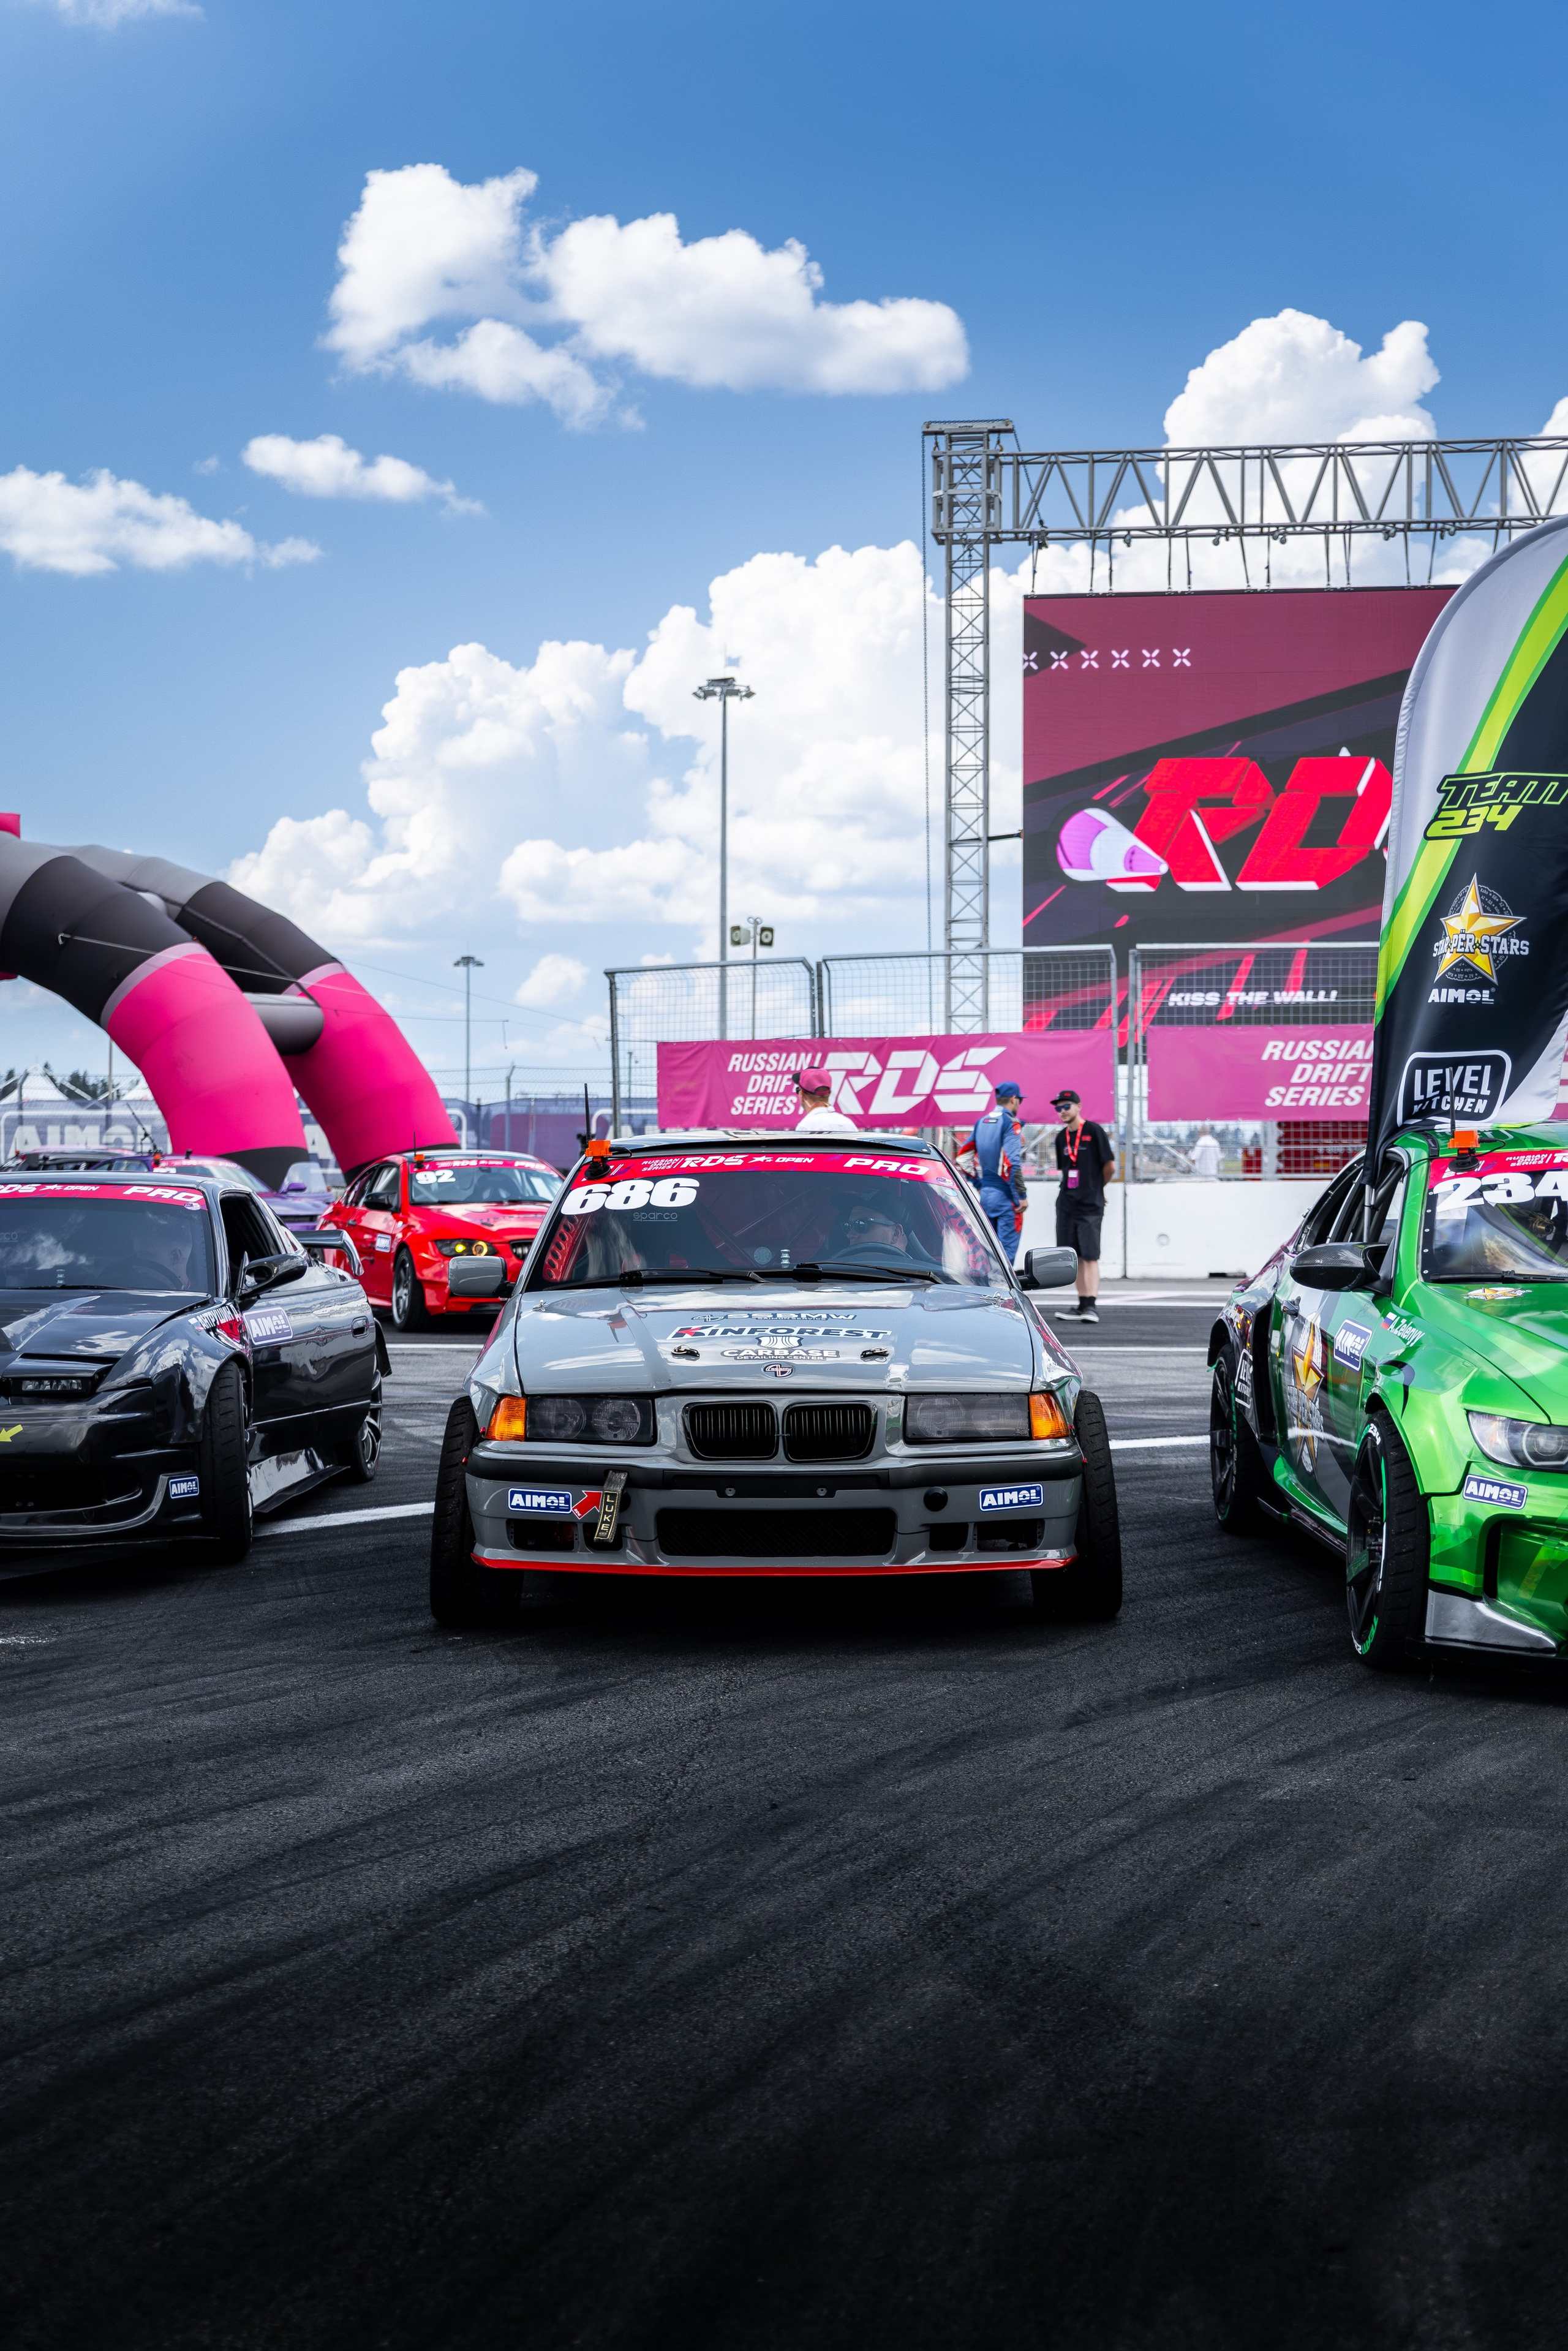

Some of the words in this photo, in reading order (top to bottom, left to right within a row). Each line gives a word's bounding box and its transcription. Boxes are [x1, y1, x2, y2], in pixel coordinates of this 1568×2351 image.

[1106, 757, 1393, 892] RD
[1426, 805, 1523, 837] 234
[1480, 934, 1529, 955] STARS
[1168, 991, 1220, 1006] KISS
[1226, 991, 1269, 1005] THE
[1273, 990, 1338, 1005] WALL!
[727, 1052, 813, 1072] RUSSIAN
[747, 1074, 797, 1093] DRIF
[823, 1047, 1007, 1115] RDS
[1414, 1065, 1491, 1101] LEVEL
[730, 1095, 798, 1115] SERIES
[1264, 1085, 1366, 1107] SERIES
[680, 1155, 748, 1168] RDS
[843, 1157, 929, 1176] PRO
[415, 1169, 456, 1185] 92
[0, 1184, 42, 1194] DS
[123, 1186, 203, 1202] PRO
[563, 1177, 699, 1215] 686
[1433, 1171, 1568, 1212] 234
[633, 1212, 677, 1222] sparco
[672, 1326, 888, 1339] KINFOREST
[723, 1349, 838, 1357] CARBASE
